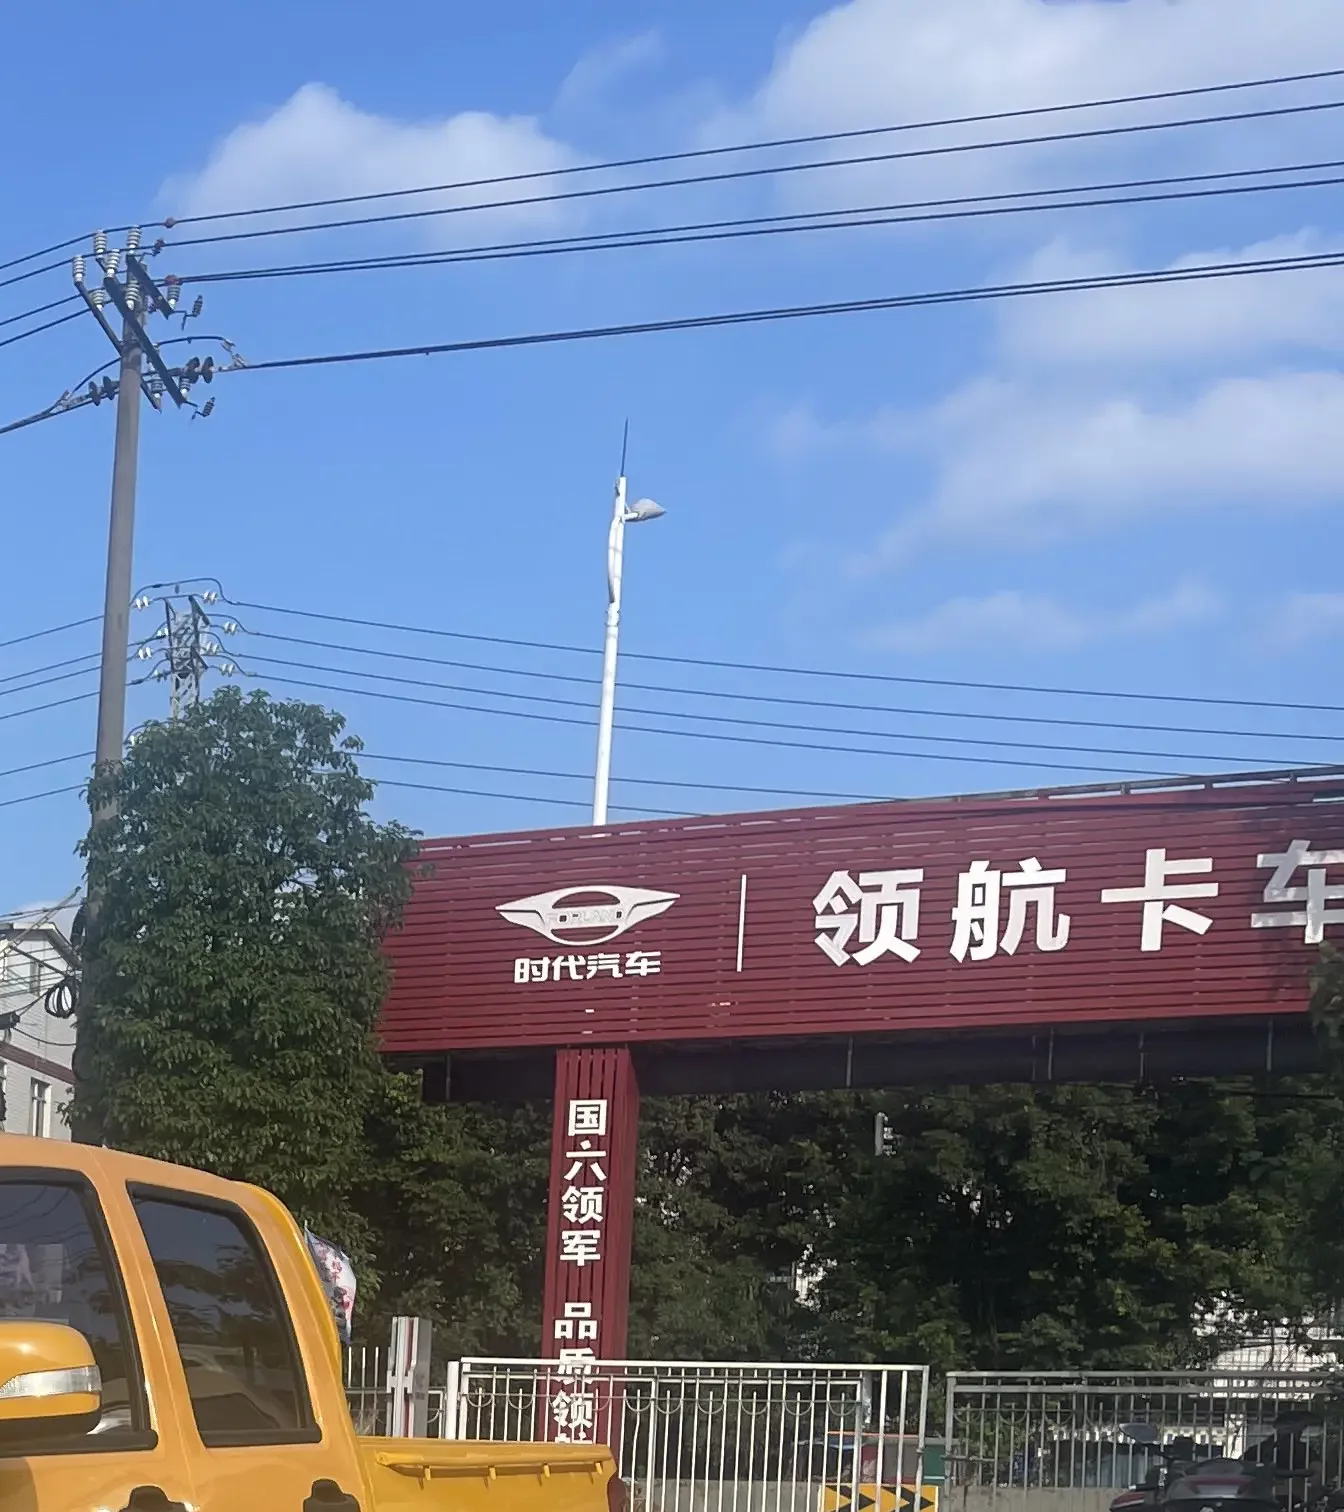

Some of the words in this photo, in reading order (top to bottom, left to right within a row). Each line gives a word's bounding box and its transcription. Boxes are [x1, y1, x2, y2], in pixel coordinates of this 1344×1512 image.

[514, 951, 661, 983] 时代汽车
[812, 840, 1344, 967] 领航卡车
[560, 1098, 609, 1267] 国六领军
[551, 1301, 599, 1444] 品质领
